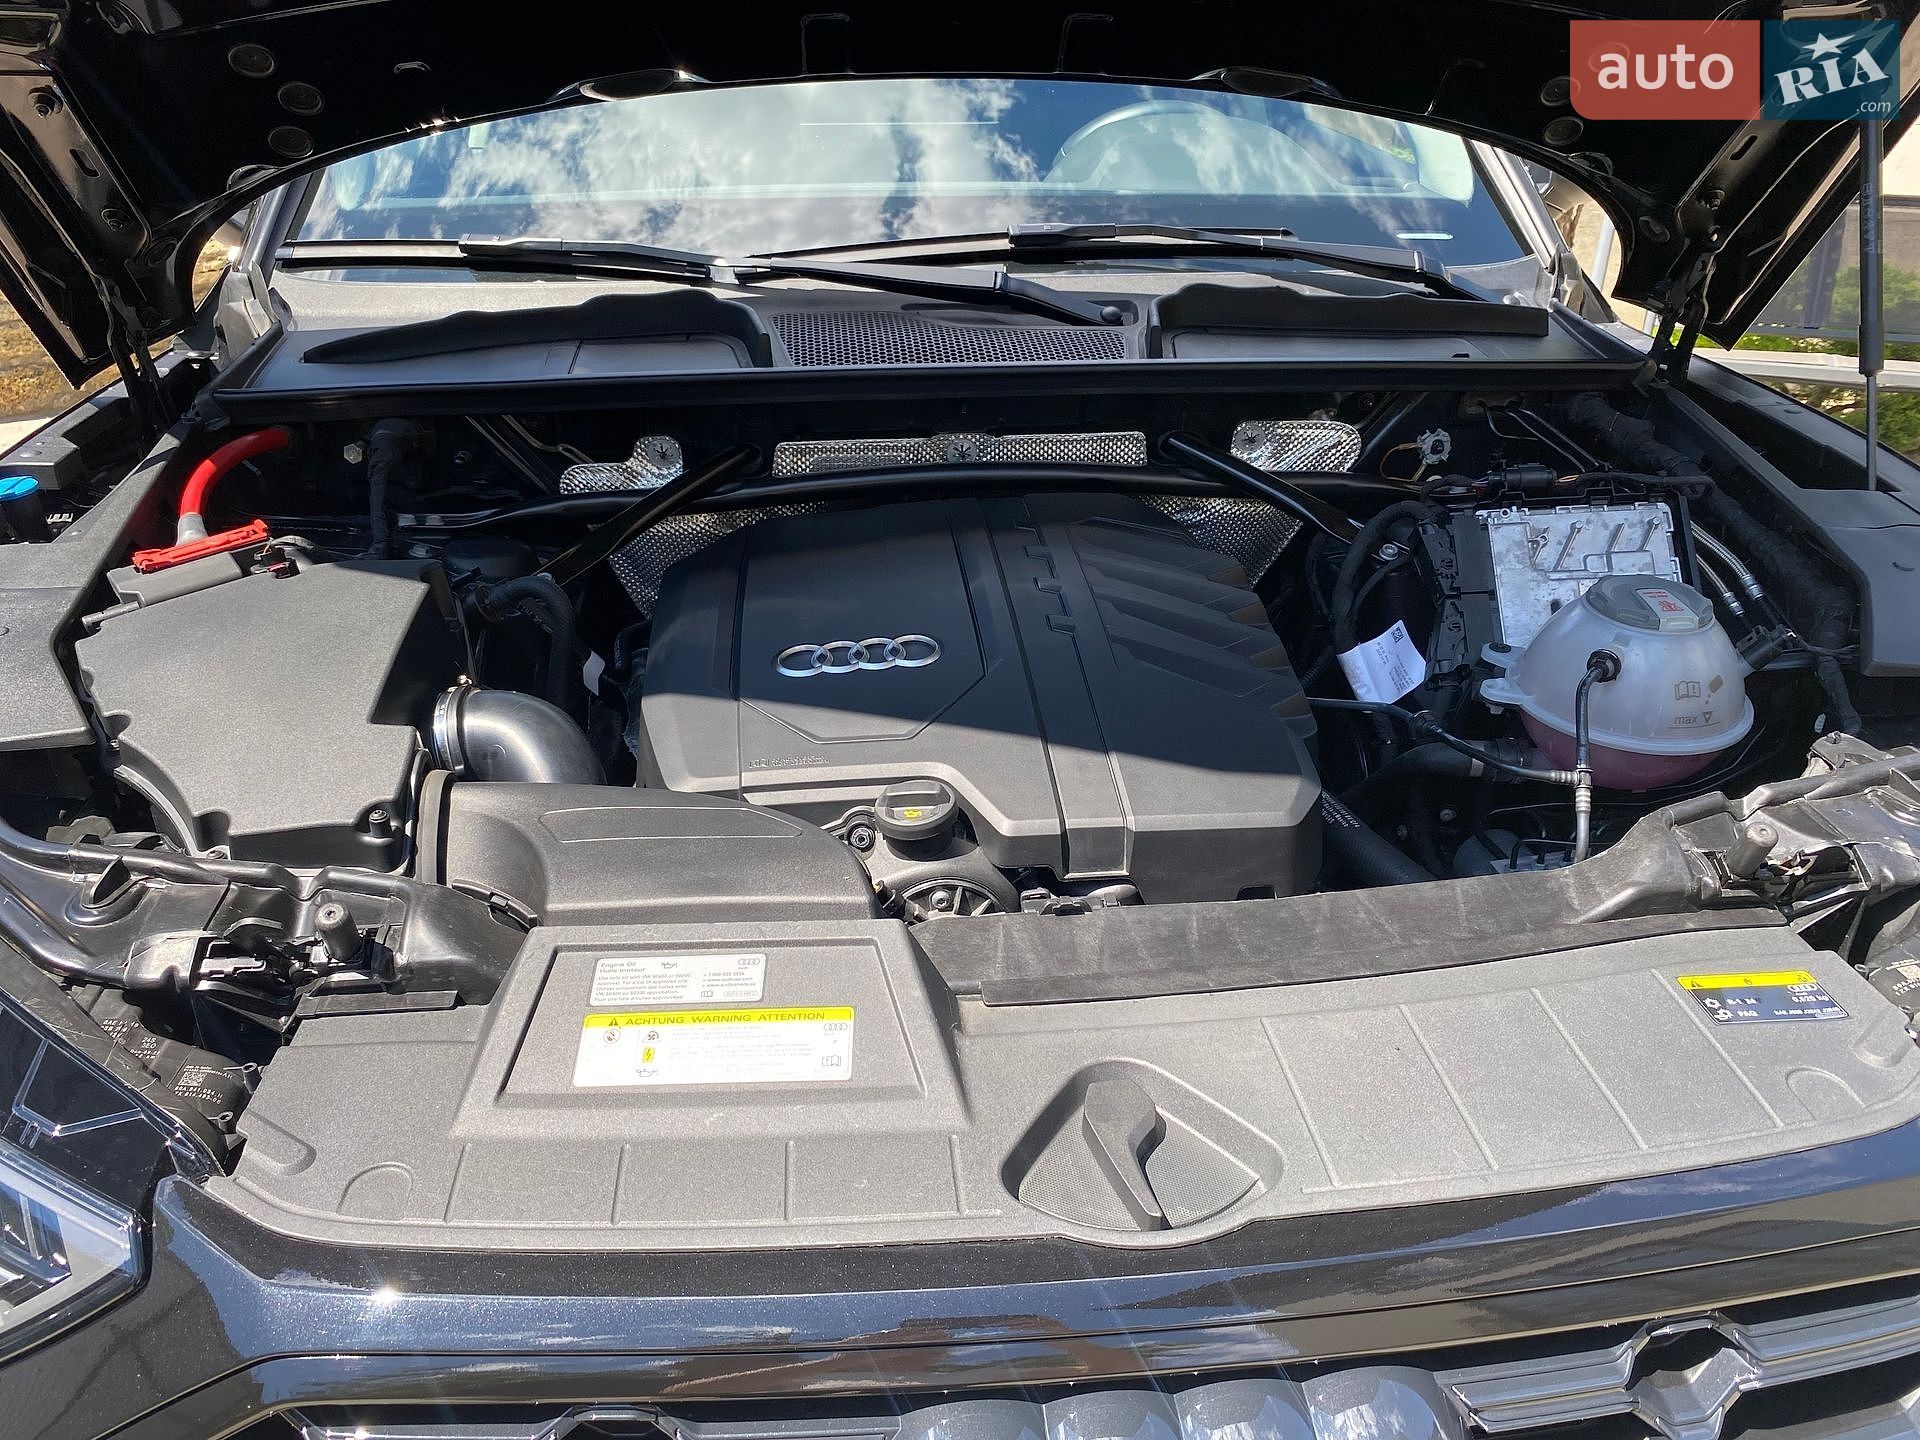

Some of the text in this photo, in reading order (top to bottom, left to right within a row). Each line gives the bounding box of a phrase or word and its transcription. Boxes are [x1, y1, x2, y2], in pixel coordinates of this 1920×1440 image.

[1674, 715, 1697, 725] max
[625, 1012, 825, 1026] ACHTUNG WARNING ATTENTION
